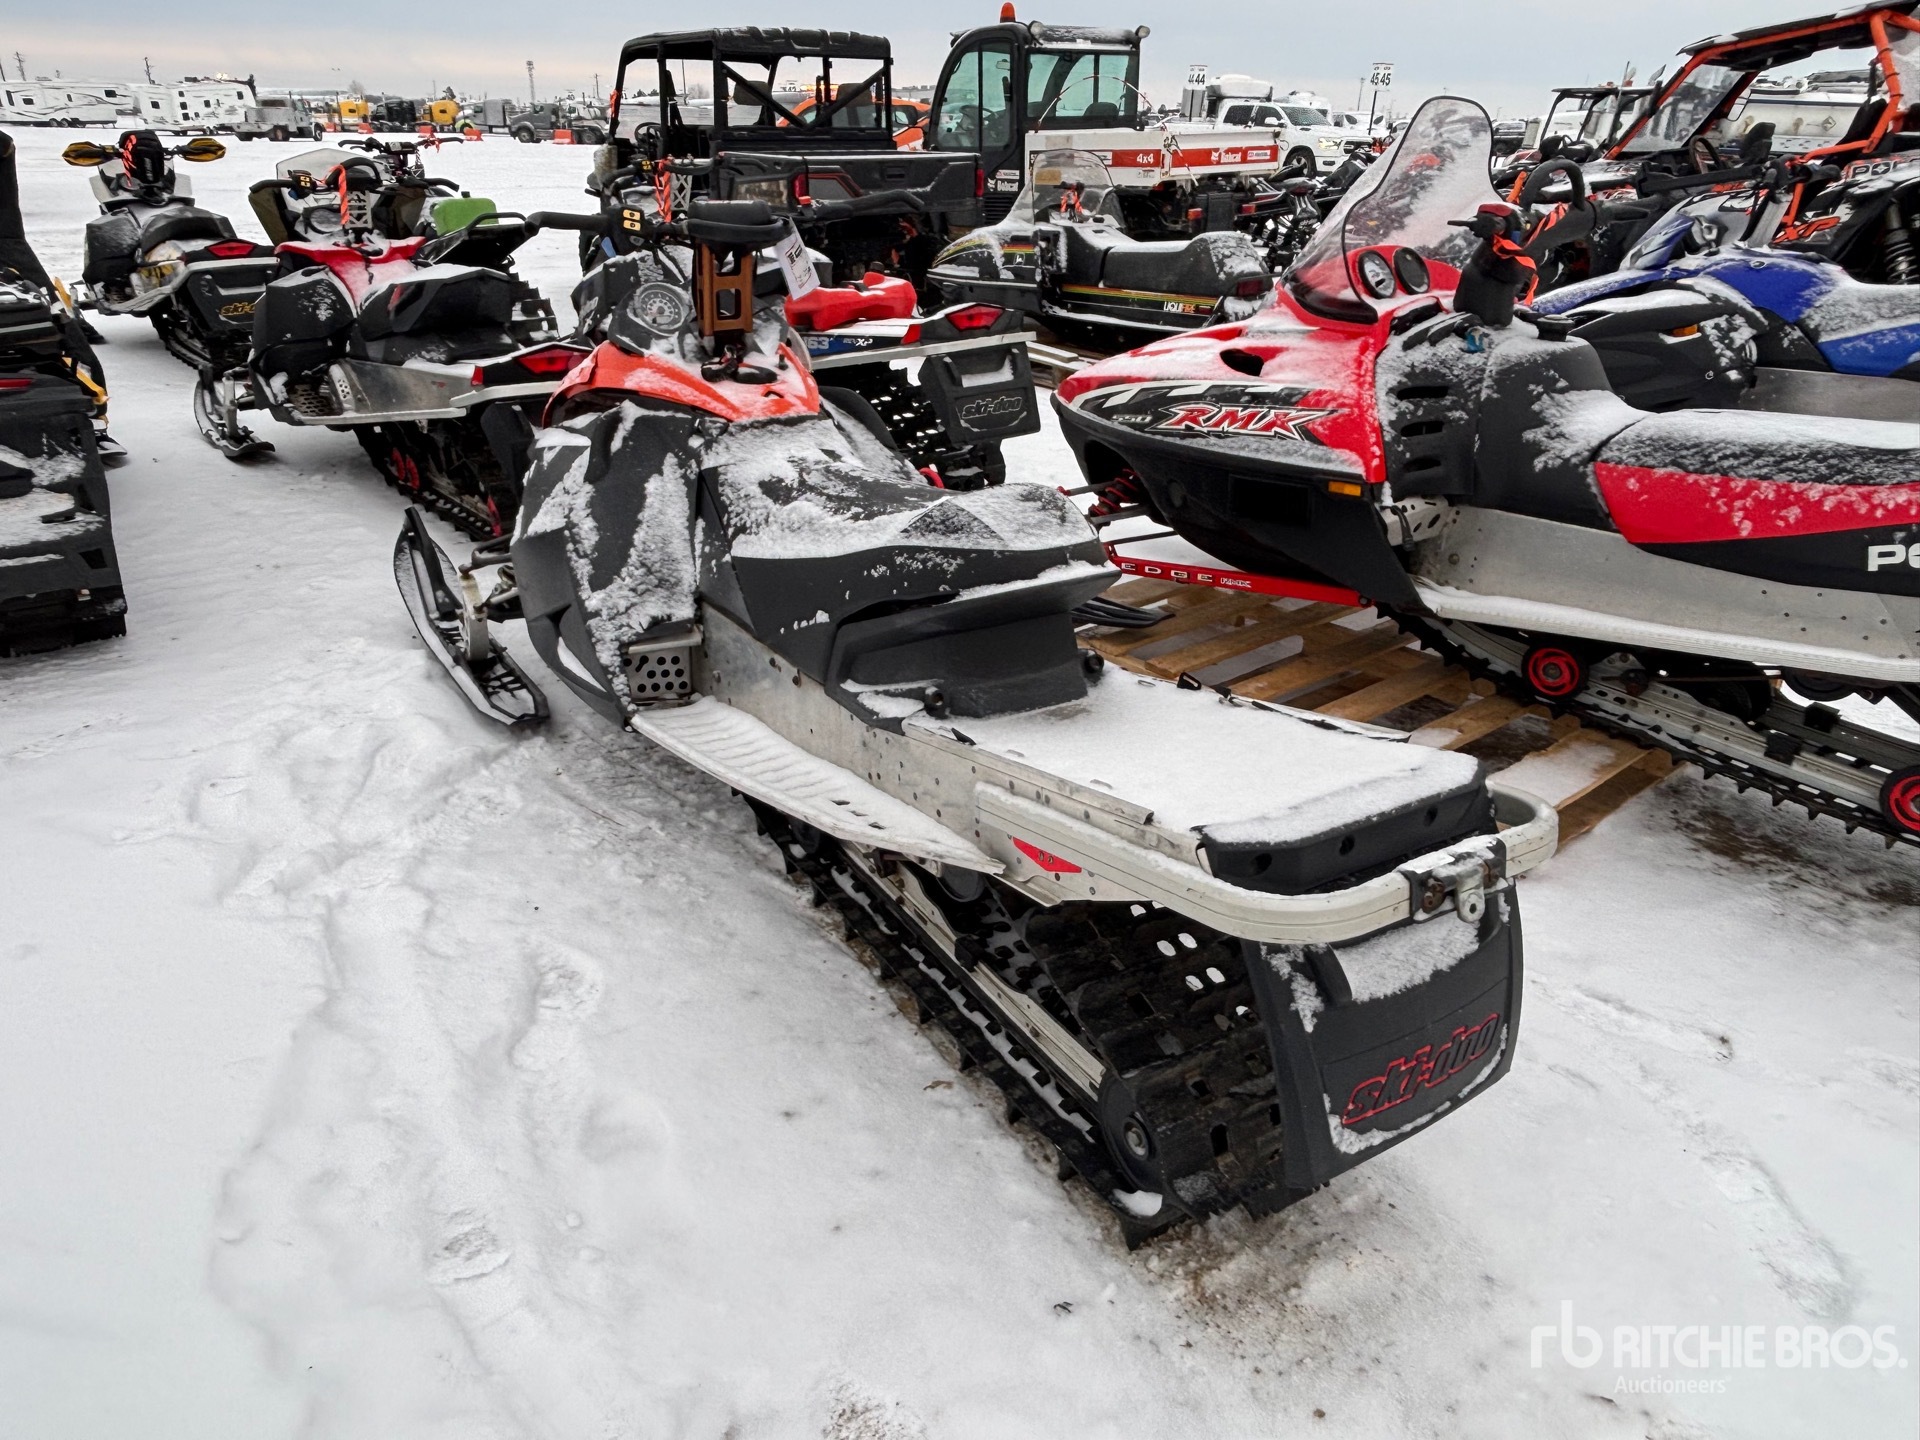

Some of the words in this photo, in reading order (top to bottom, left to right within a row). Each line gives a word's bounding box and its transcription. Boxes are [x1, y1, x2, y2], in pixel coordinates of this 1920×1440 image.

[1195, 73, 1205, 85] 44
[1370, 72, 1380, 86] 45
[1380, 72, 1391, 86] 45
[1136, 153, 1154, 164] 4x4
[1150, 402, 1339, 441] RMK
[1120, 562, 1214, 583] EDGE
[1341, 1012, 1501, 1126] ski-doo
